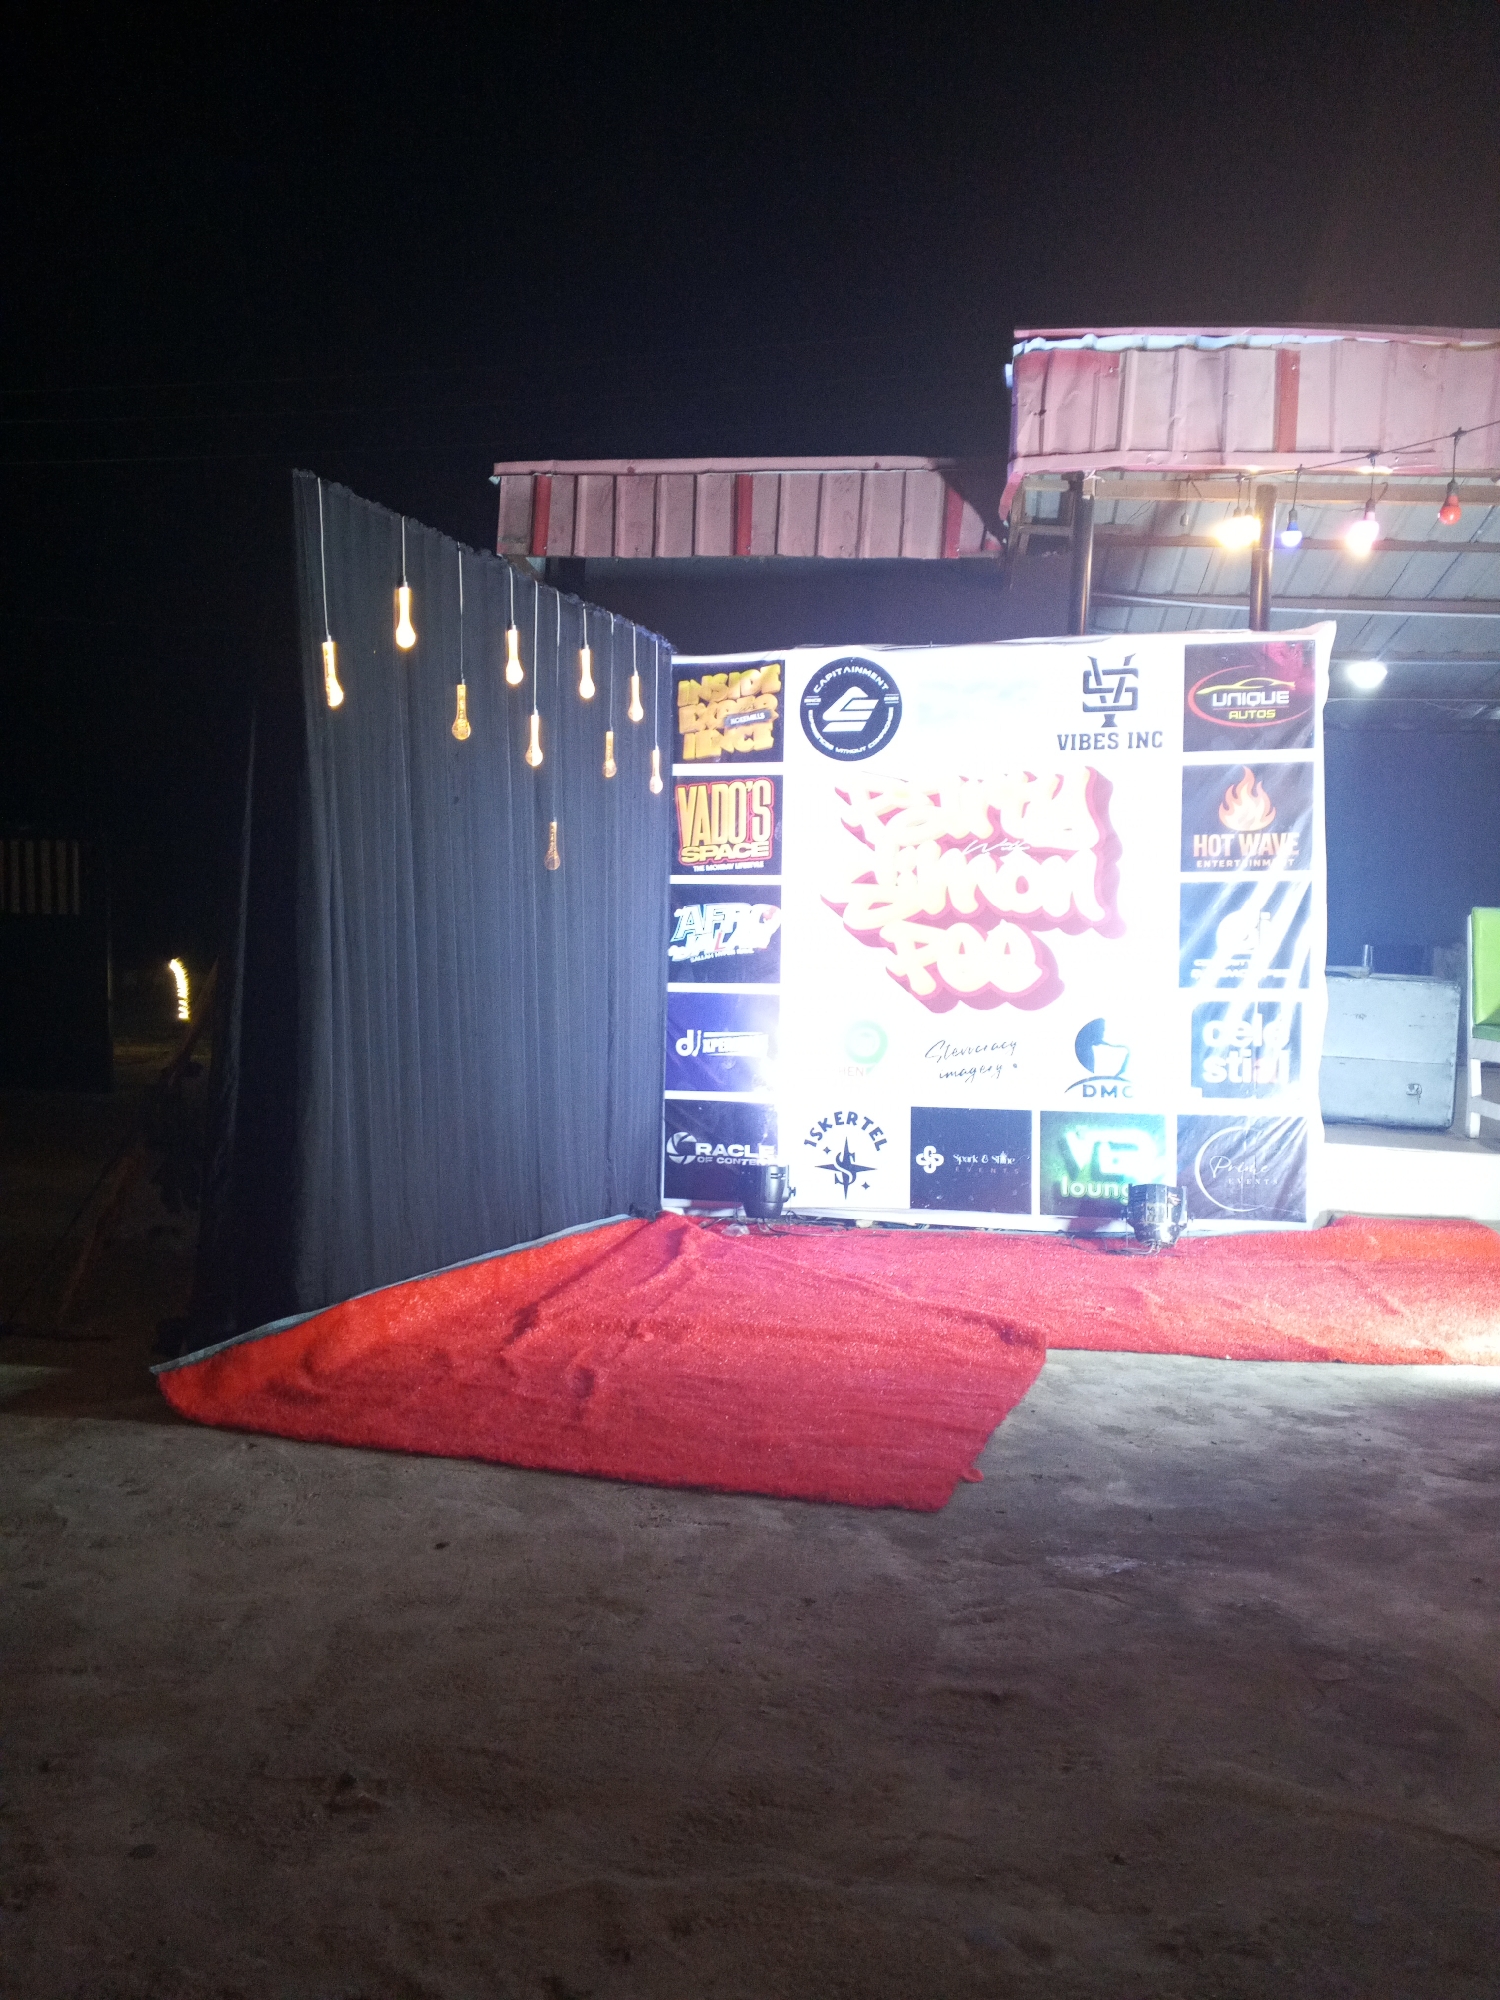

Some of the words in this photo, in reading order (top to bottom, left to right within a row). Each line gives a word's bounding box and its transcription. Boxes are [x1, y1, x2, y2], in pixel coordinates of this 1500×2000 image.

[678, 663, 782, 707] INSIDE
[813, 666, 889, 693] CAPITAINMENT
[1212, 691, 1290, 707] UNIQUE
[1228, 709, 1276, 720] AUTOS
[1057, 733, 1120, 751] VIBES
[1128, 731, 1164, 749] INC
[681, 841, 771, 863] SPACE
[1193, 834, 1236, 857] HOT
[1239, 831, 1301, 857] WAVE
[803, 1111, 889, 1153] ISKERTEL
[696, 1156, 714, 1164] OF
[953, 1153, 979, 1166] Spark
